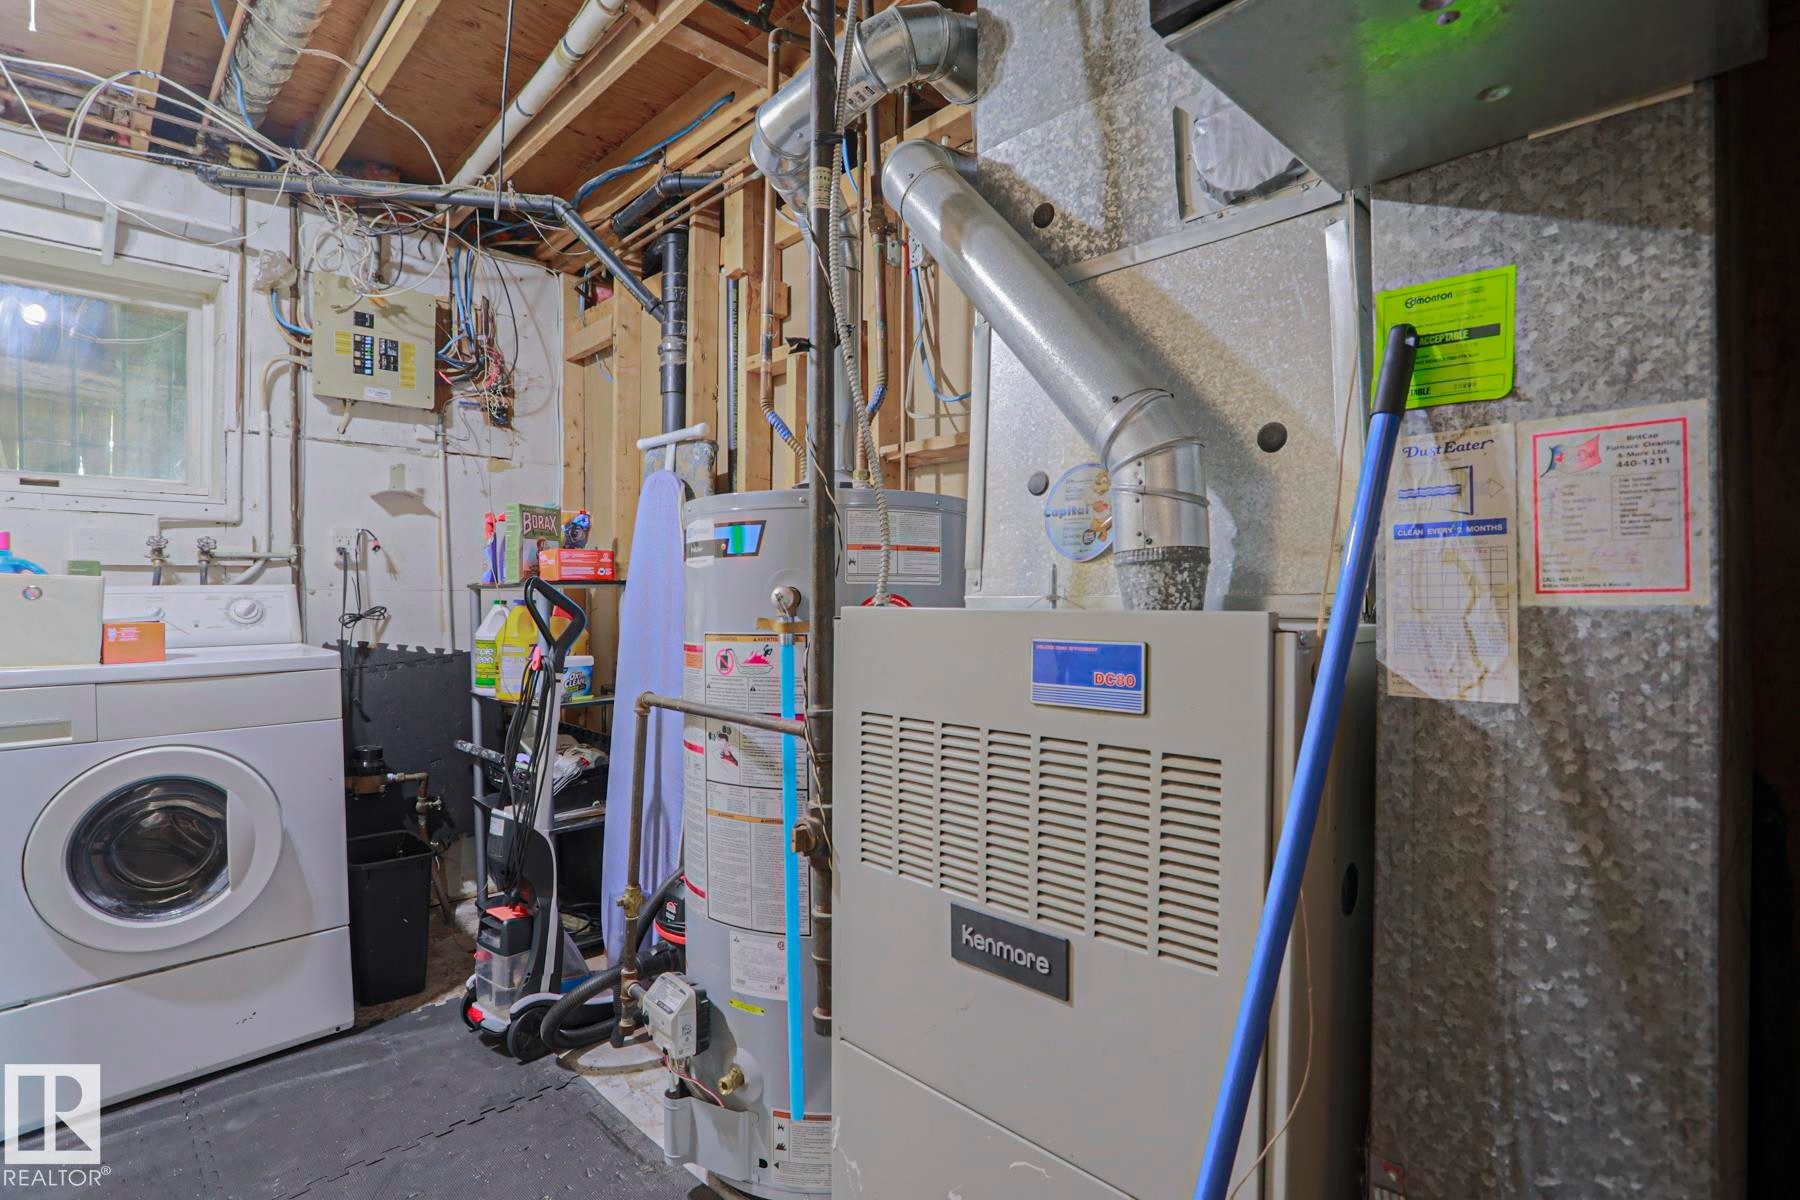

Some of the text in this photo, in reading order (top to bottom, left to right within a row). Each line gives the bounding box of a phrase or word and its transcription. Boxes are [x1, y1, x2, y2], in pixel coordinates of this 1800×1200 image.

[1405, 292, 1453, 309] Edmonton
[1402, 439, 1494, 459] Dust Eater
[1606, 439, 1681, 452] Furnace Cleaning
[1616, 457, 1671, 469] 440-1211
[523, 512, 558, 537] BORAX
[1397, 527, 1424, 538] CLEAN
[1427, 526, 1453, 536] EVERY
[1466, 523, 1504, 533] MONTHS
[1093, 671, 1136, 688] DC80
[961, 924, 1051, 975] Kenmore
